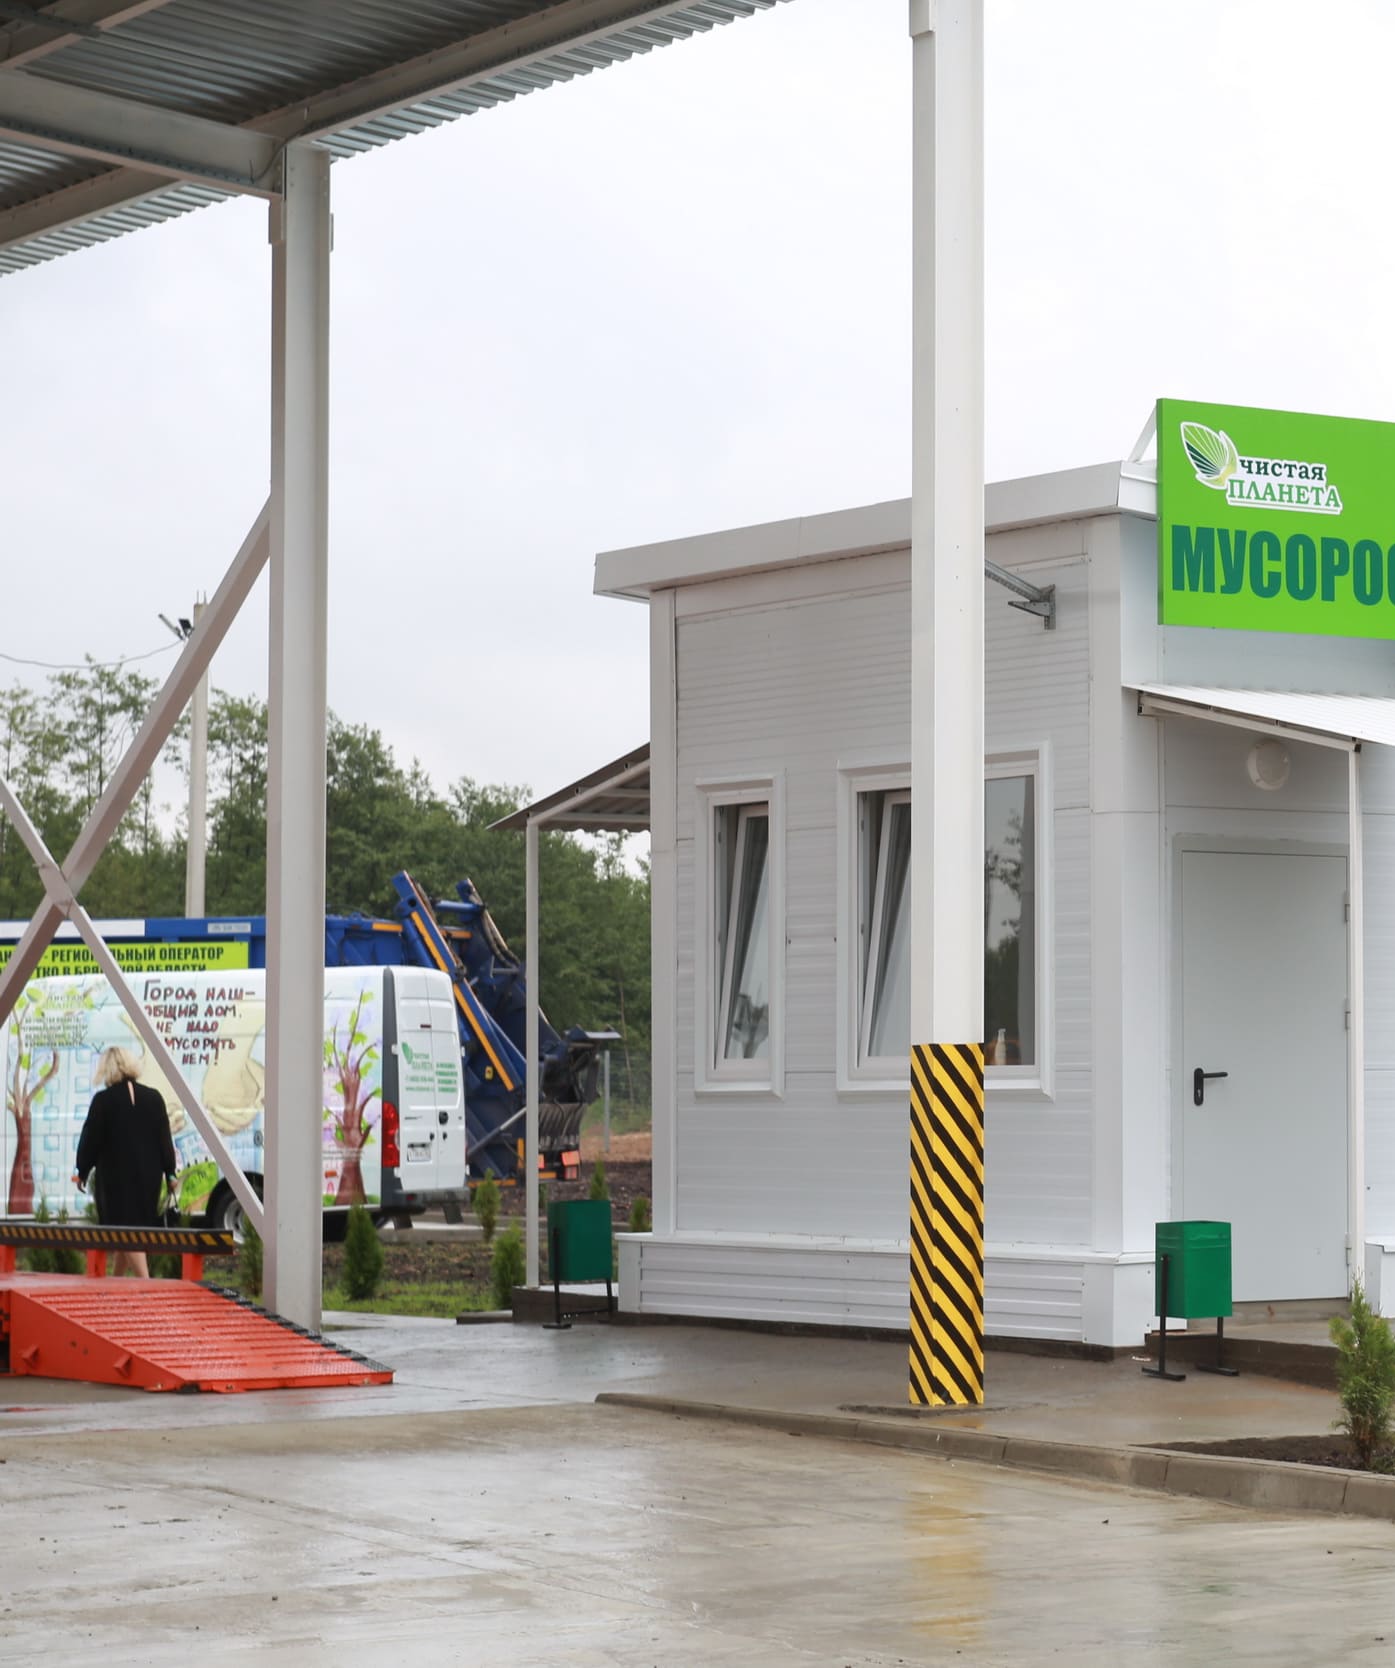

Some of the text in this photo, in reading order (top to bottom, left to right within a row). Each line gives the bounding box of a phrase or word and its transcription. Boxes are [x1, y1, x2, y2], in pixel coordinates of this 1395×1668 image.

[1239, 459, 1324, 481] чистая
[1228, 479, 1341, 508] ПЛАНЕТА
[160, 947, 224, 960] ОПЕРАТОР
[144, 979, 197, 1000] ГОРОД
